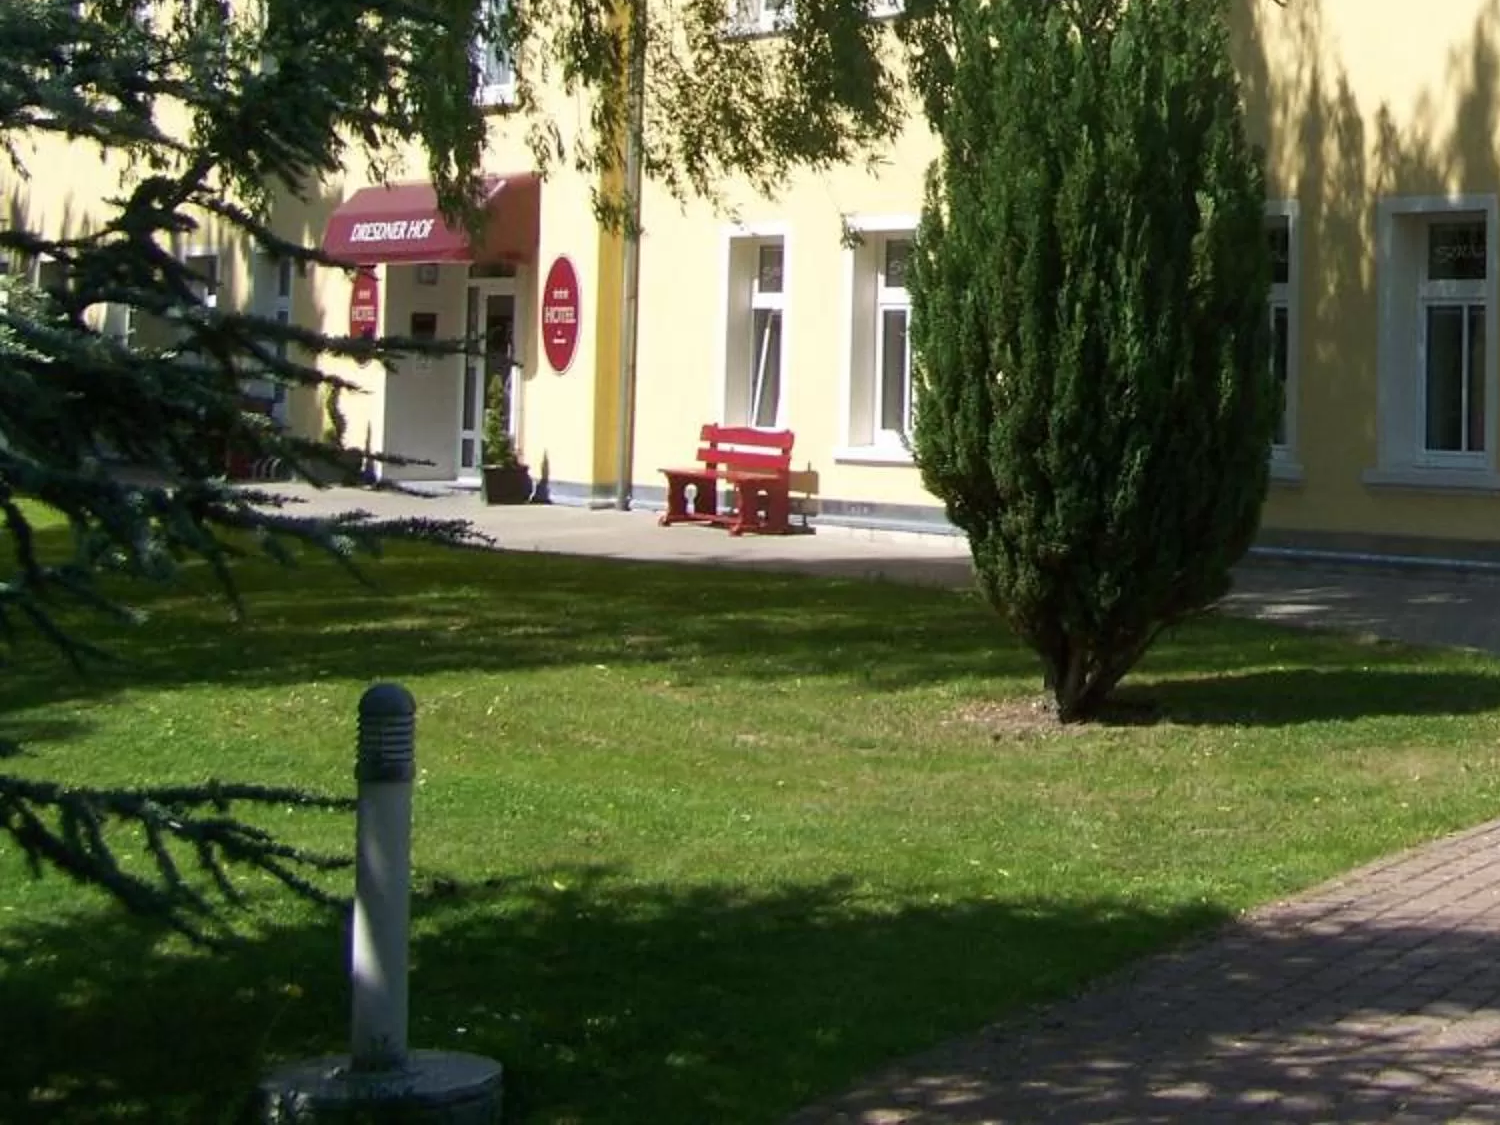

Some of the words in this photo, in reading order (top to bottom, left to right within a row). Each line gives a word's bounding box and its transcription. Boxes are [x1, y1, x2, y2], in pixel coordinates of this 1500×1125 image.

[350, 221, 408, 242] DRESDNER
[406, 218, 435, 240] HOF
[351, 305, 376, 322] HOTEL
[543, 306, 577, 324] HOTEL
